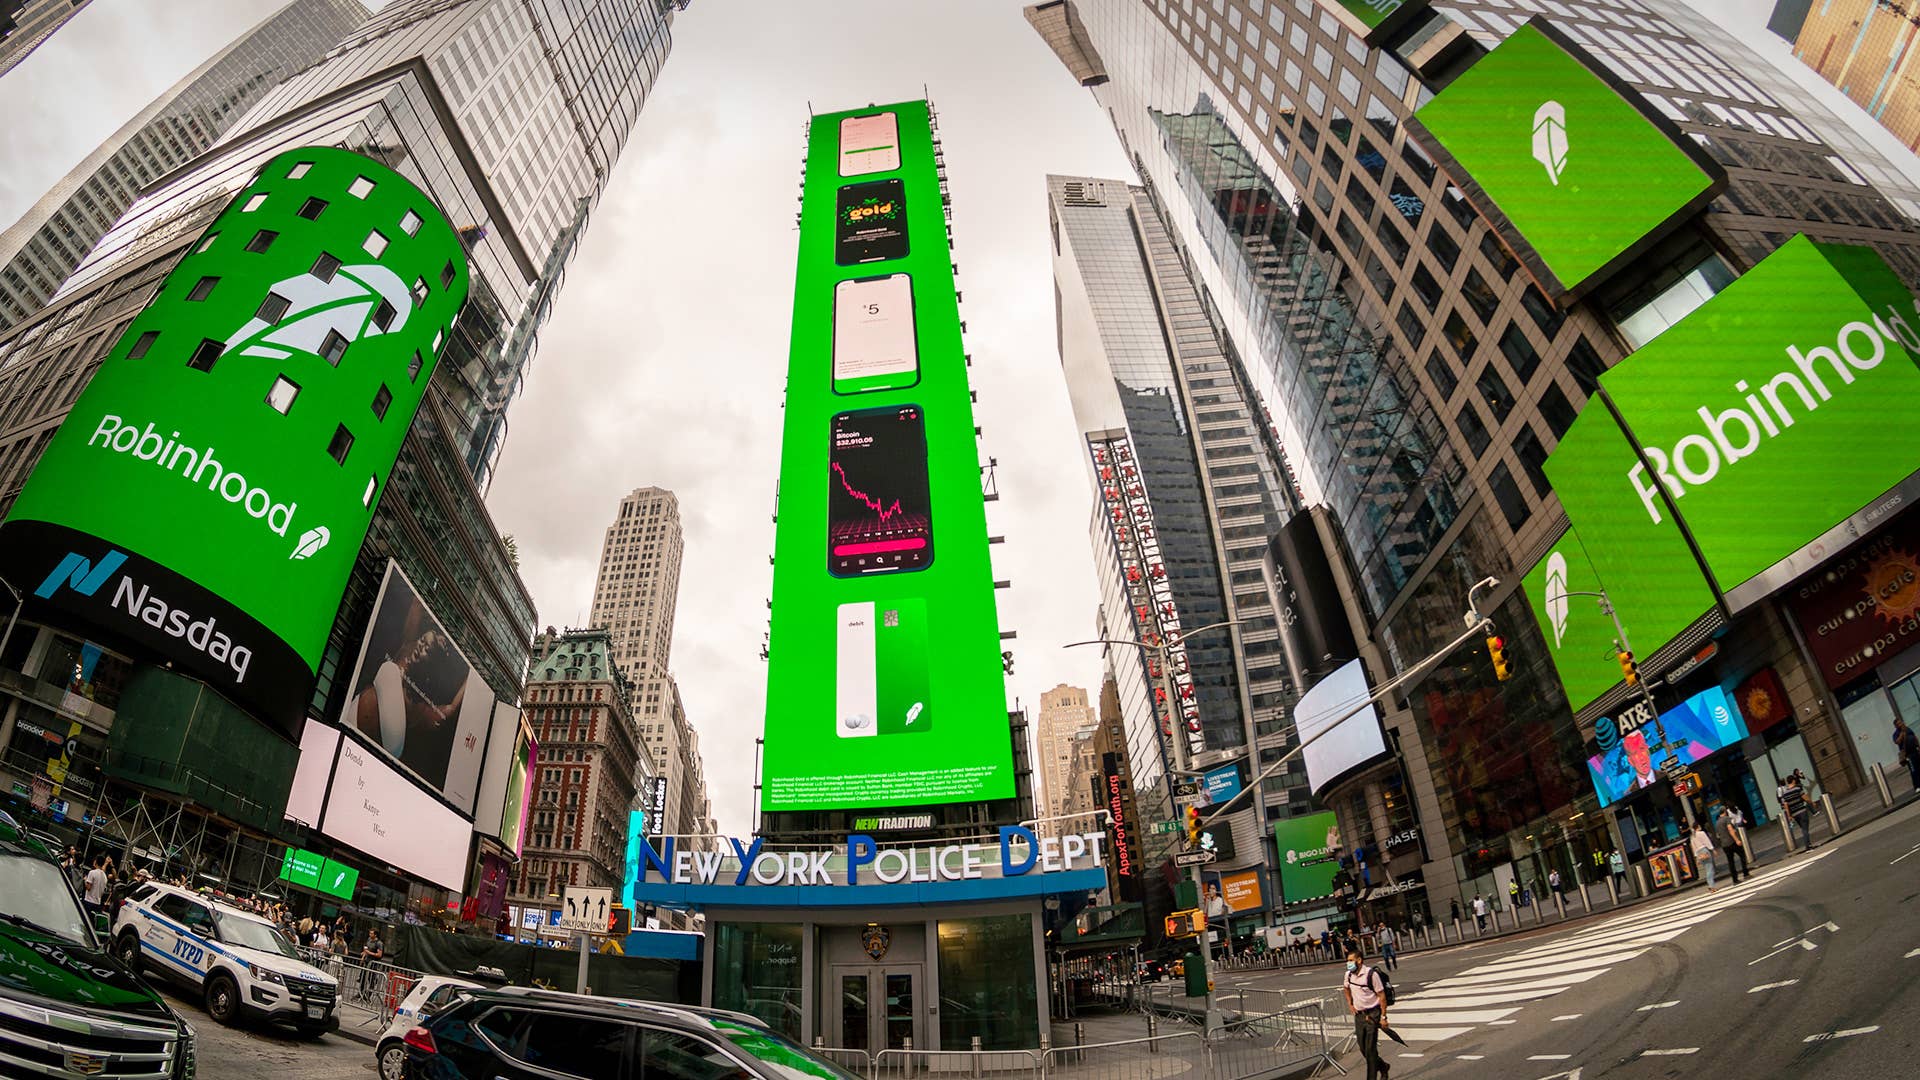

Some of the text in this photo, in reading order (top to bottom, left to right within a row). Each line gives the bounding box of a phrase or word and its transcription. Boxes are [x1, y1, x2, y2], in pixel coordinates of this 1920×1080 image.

[849, 202, 892, 220] gold
[836, 431, 860, 440] Bitcoin
[88, 414, 298, 538] Robinhood
[110, 575, 253, 685] Nasdaq
[344, 746, 364, 768] Donda
[357, 775, 366, 790] by
[363, 798, 381, 817] Kanye
[652, 779, 666, 834] Foot Locker
[372, 822, 386, 838] West
[1109, 775, 1131, 876] ApexForYouth.org
[1159, 822, 1177, 832] W 43
[638, 825, 1105, 885] NEW YORK POLICE DEPT
[561, 918, 606, 931] ONLY ONLY ONLY
[172, 937, 204, 965] NYPD
